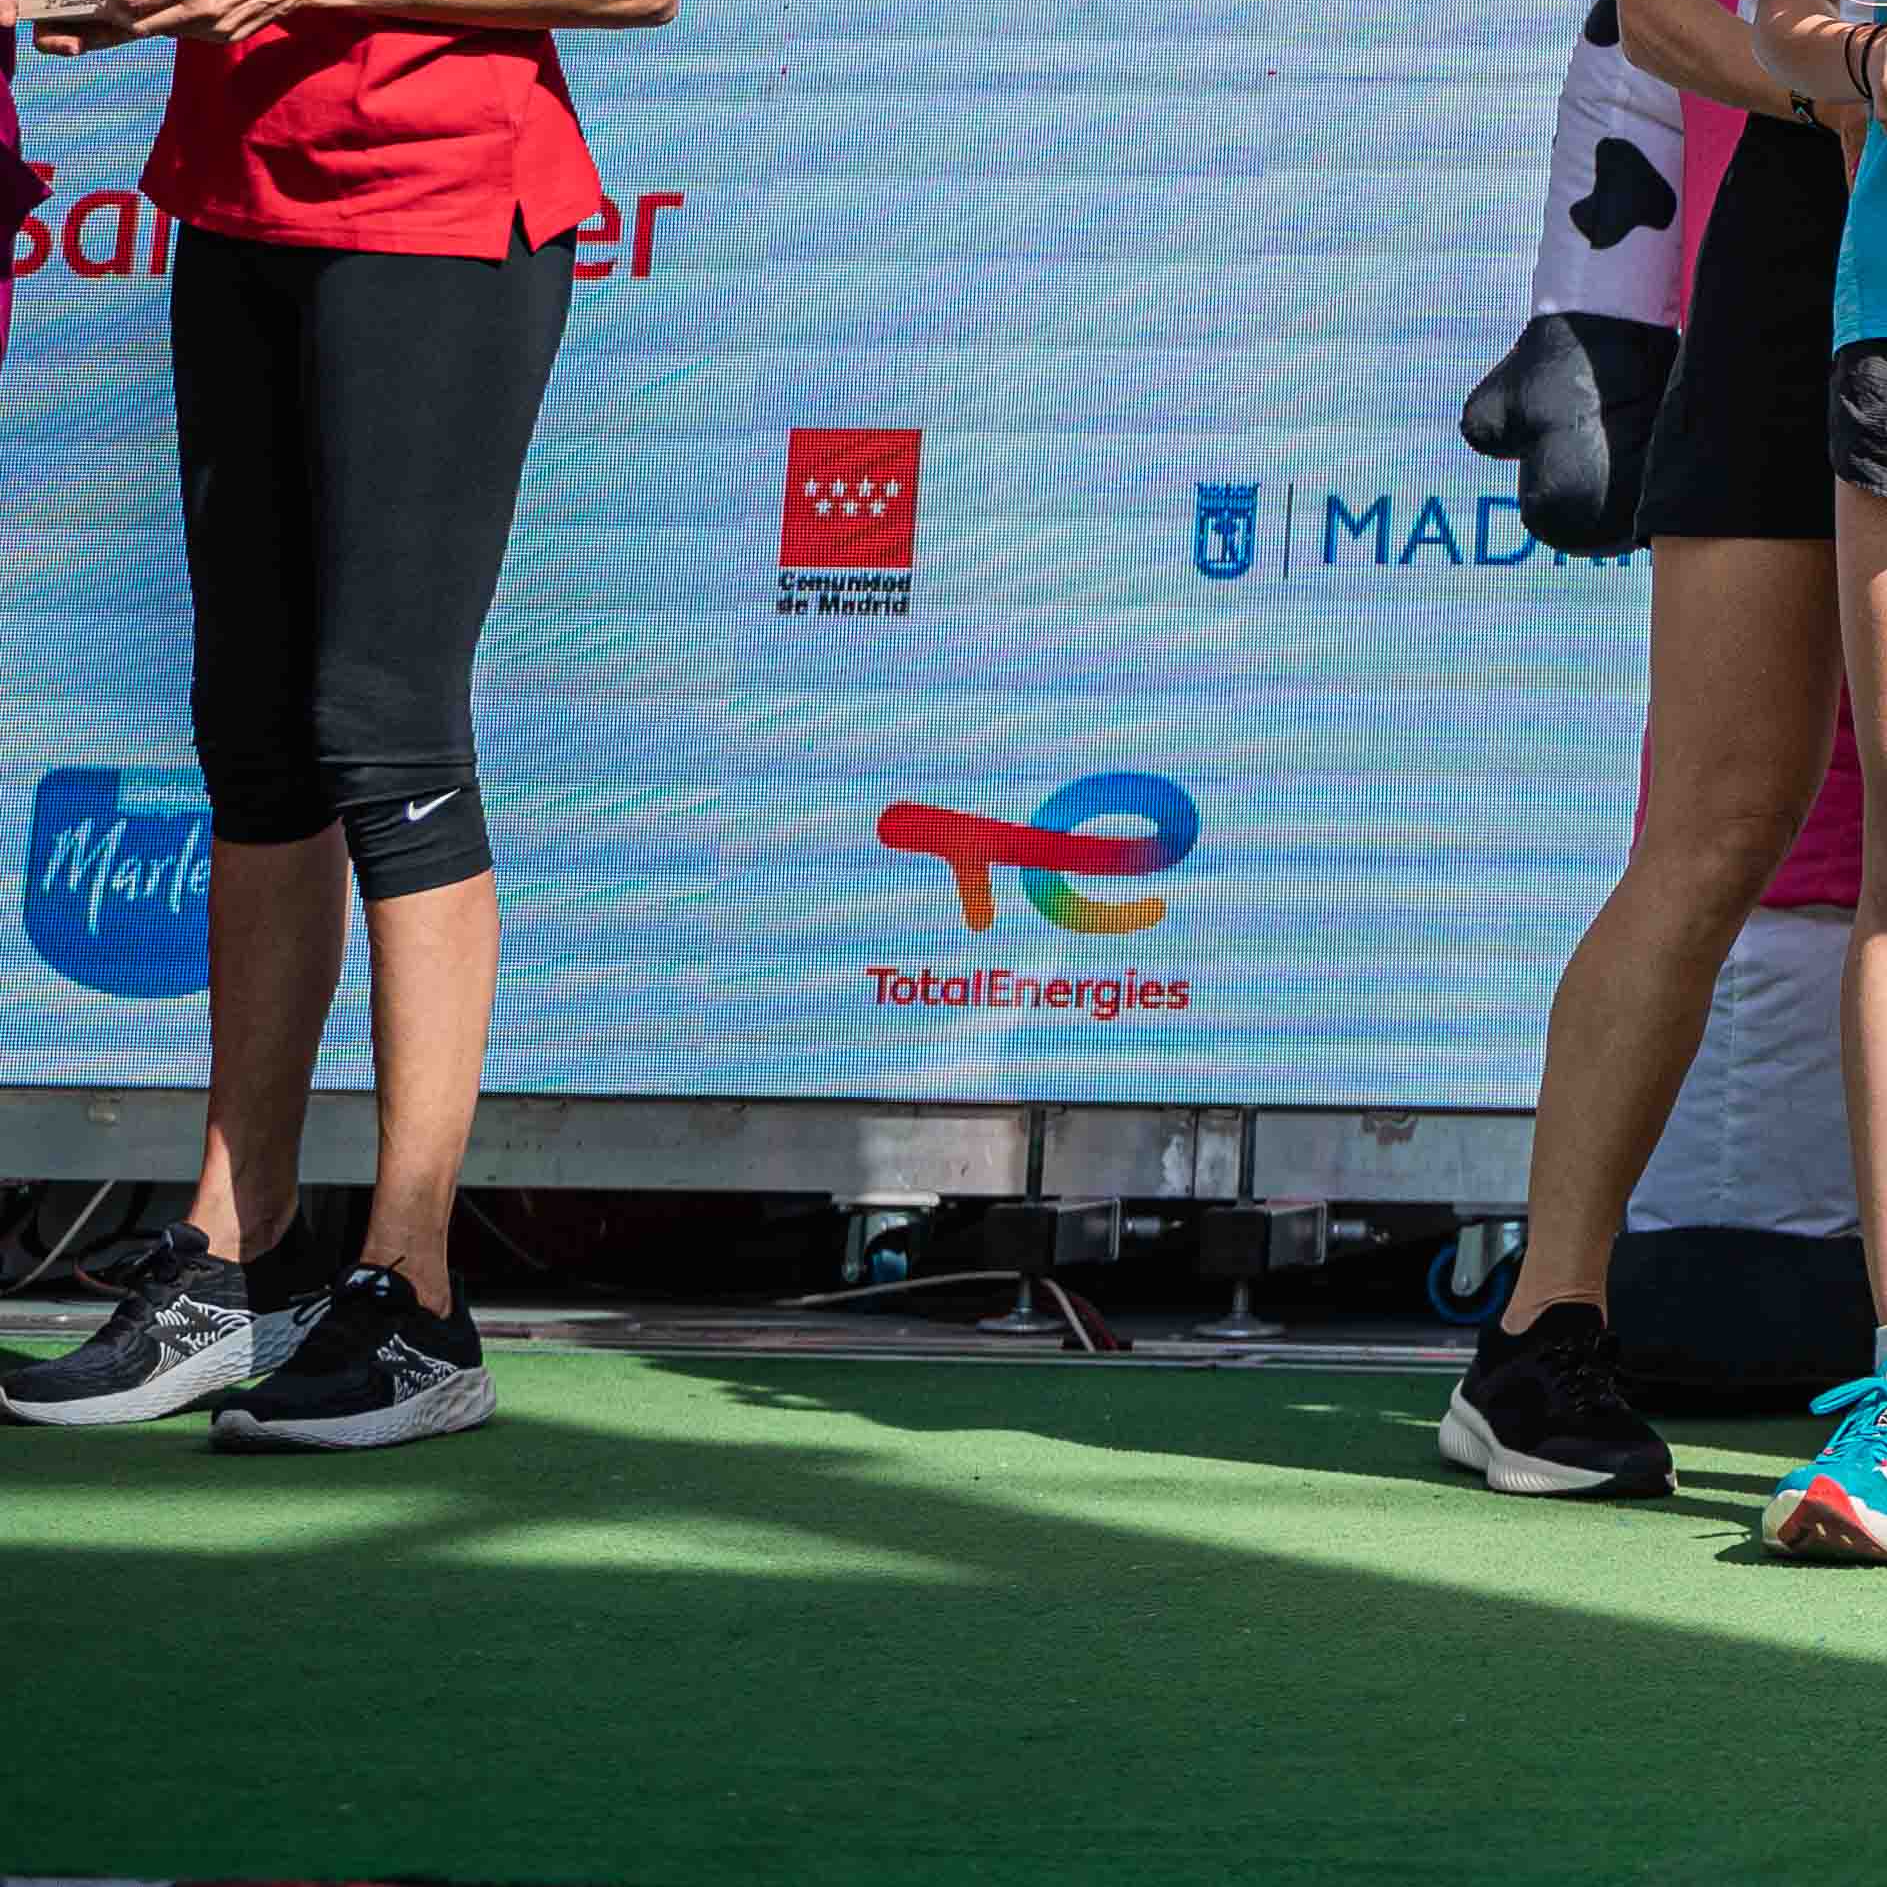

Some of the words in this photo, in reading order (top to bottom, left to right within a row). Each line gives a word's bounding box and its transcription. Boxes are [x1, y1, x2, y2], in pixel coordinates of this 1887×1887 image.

[1324, 493, 1652, 566] MAD
[776, 592, 808, 614] de
[818, 592, 910, 615] Madrid
[866, 966, 1192, 1022] TotalEnergies
